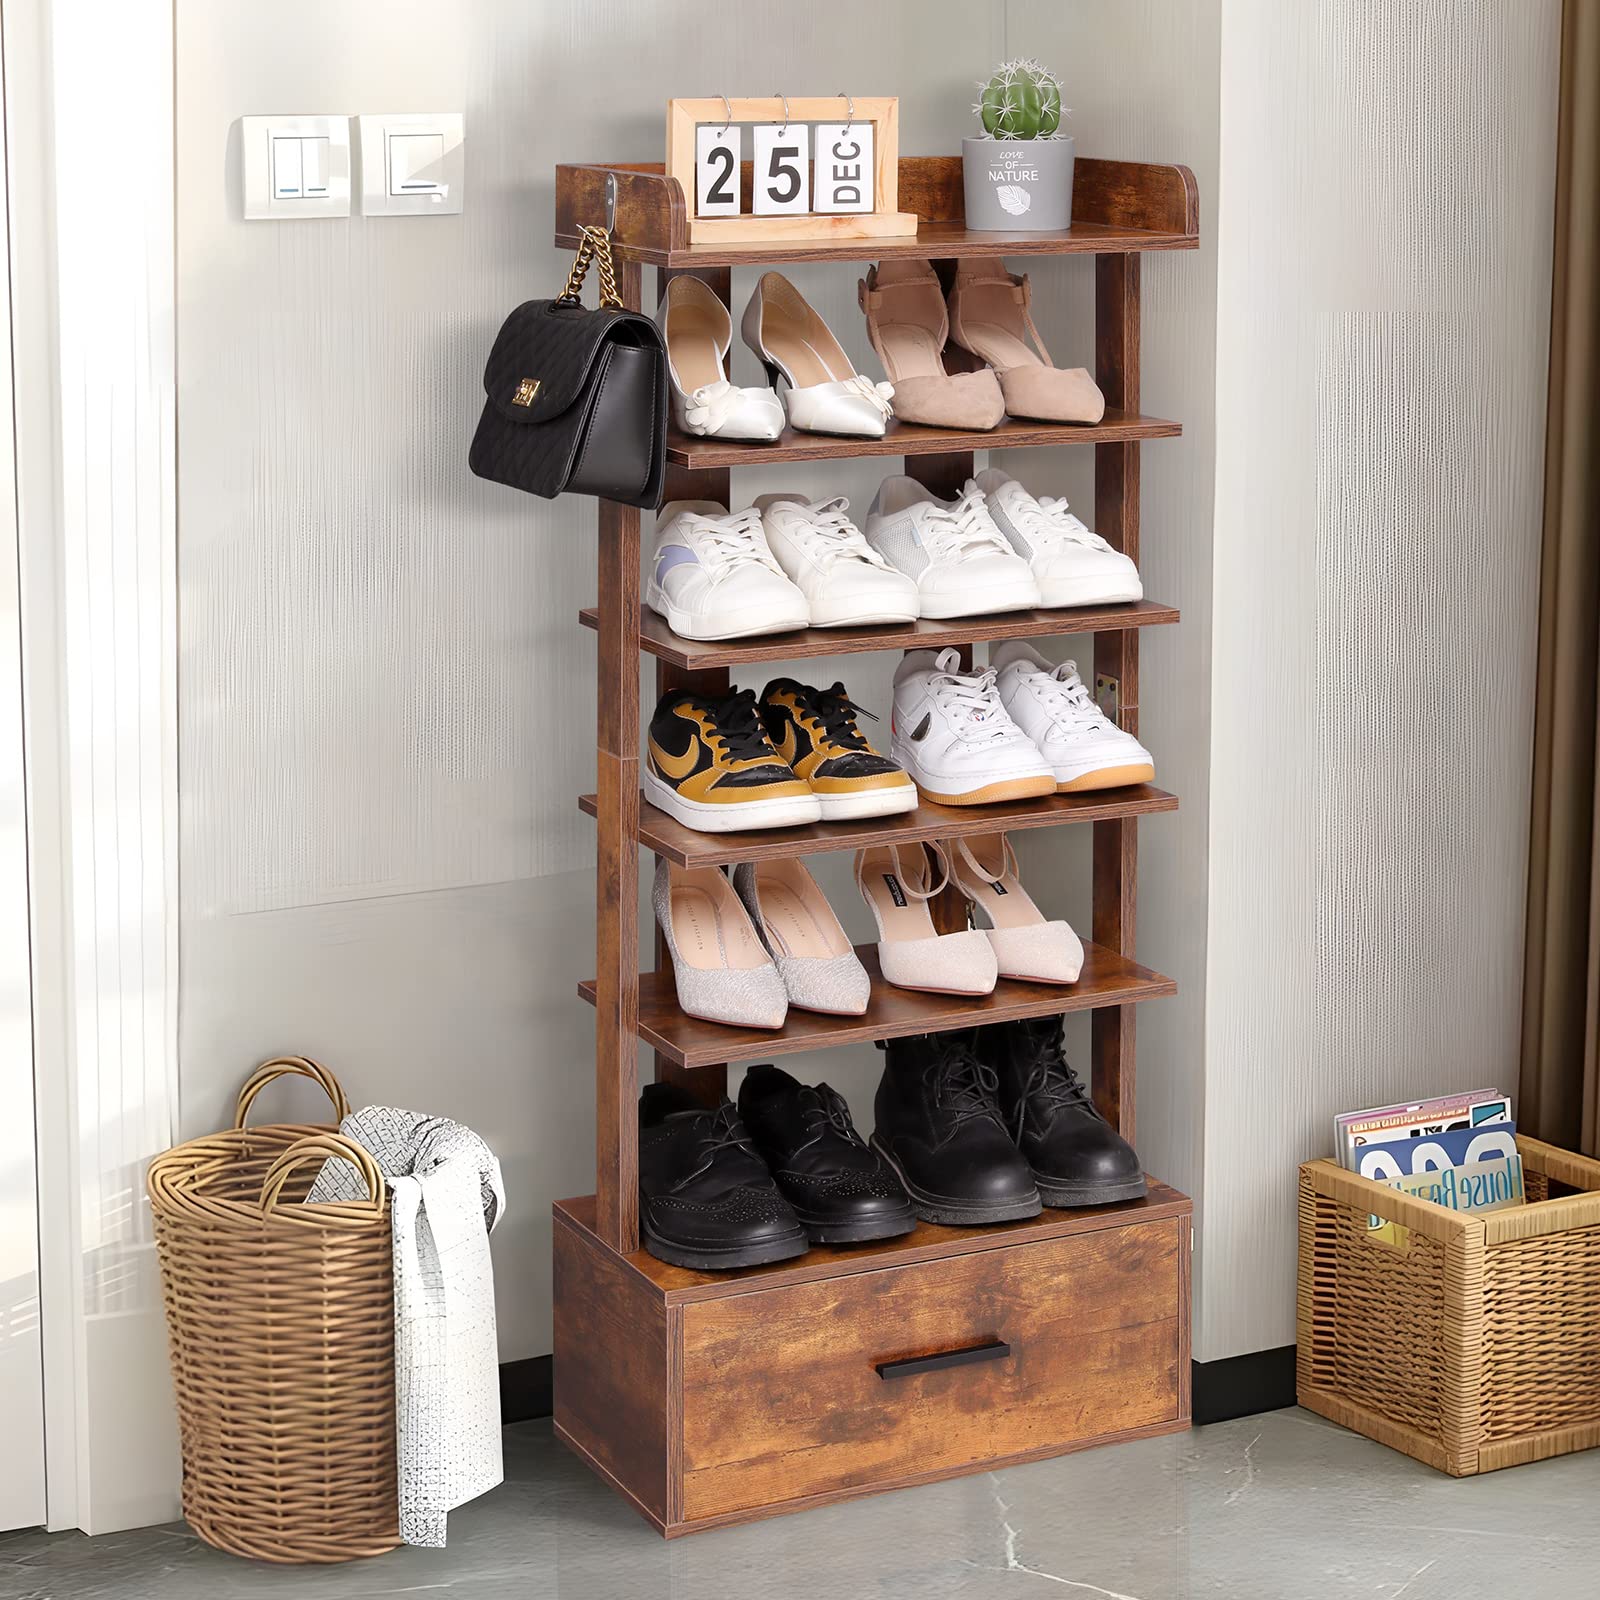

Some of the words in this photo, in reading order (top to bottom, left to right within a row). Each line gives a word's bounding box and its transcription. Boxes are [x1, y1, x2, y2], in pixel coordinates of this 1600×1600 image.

[999, 151, 1025, 159] LOVE
[1005, 161, 1019, 169] OF
[706, 146, 734, 204] 2
[767, 147, 801, 203] 5
[832, 141, 861, 204] DEC
[988, 170, 1039, 181] NATURE
